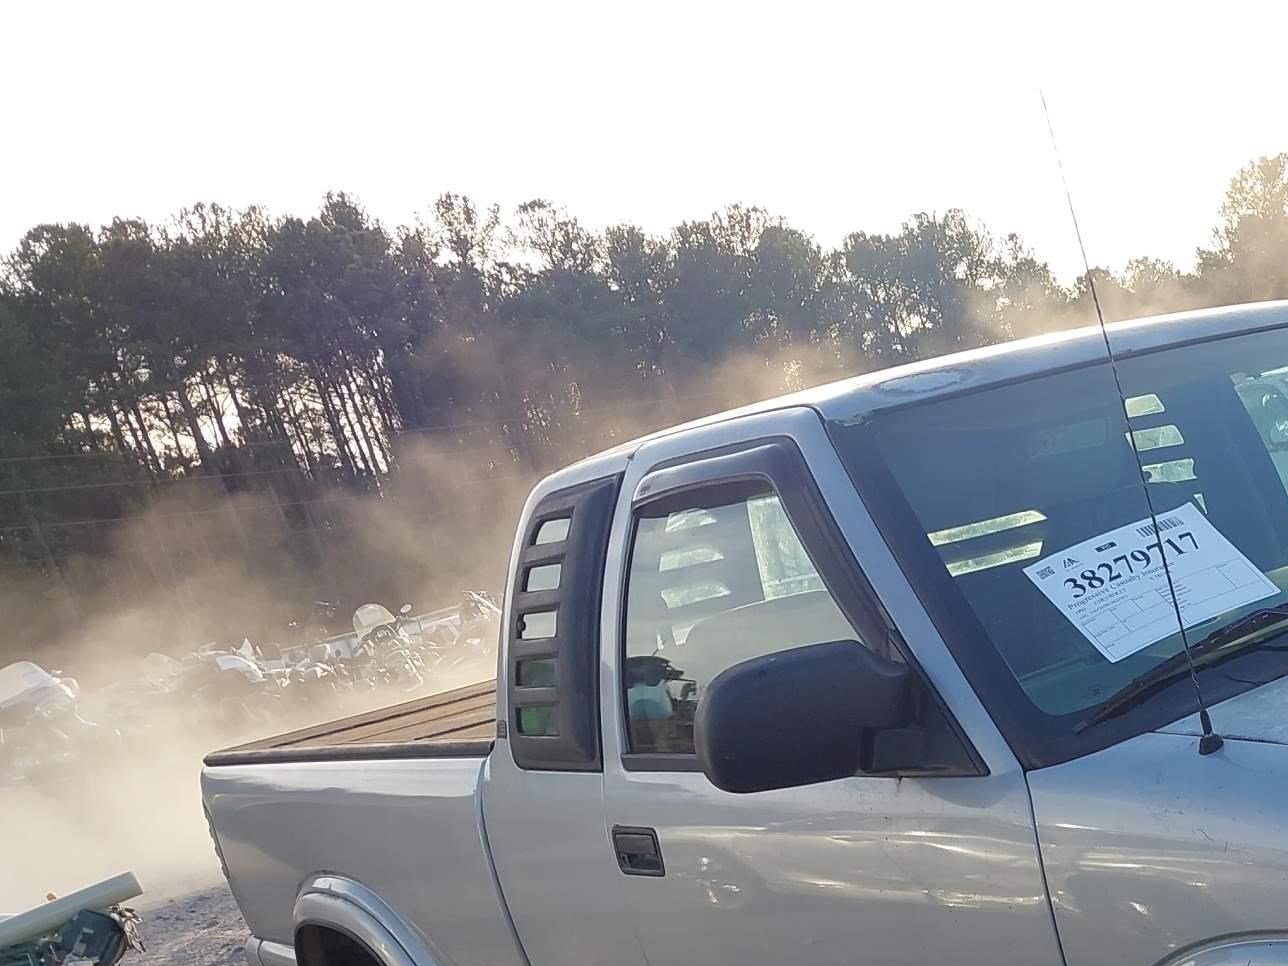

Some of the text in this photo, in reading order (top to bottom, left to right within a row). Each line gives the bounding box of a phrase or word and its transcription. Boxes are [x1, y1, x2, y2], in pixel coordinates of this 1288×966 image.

[1063, 531, 1200, 599] 38279717
[1067, 587, 1111, 611] Progressive
[1110, 572, 1142, 590] Casualty
